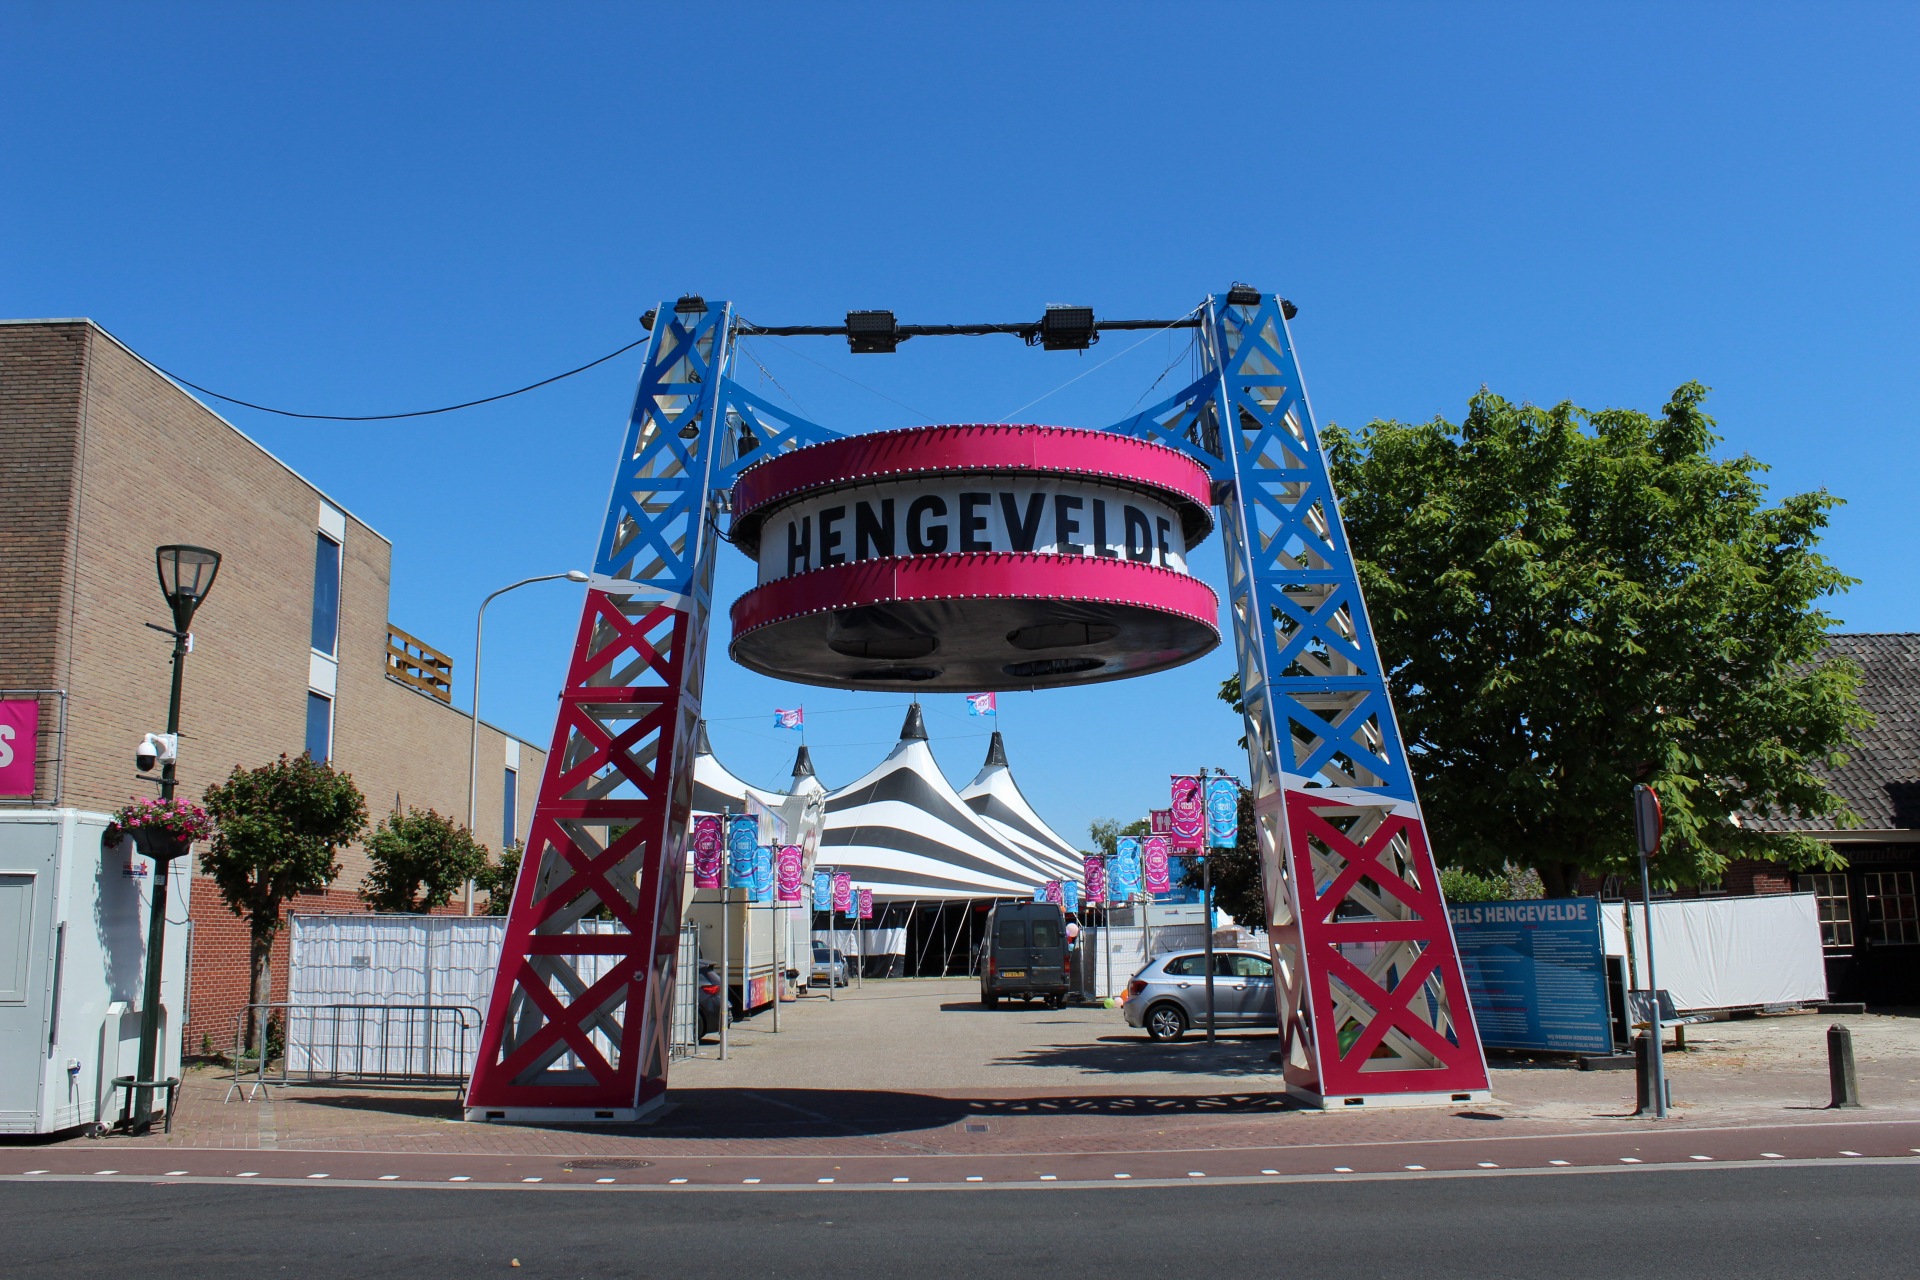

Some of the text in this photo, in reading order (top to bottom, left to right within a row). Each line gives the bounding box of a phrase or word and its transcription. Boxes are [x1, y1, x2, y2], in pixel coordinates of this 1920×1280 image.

[787, 492, 1175, 573] HENGEVELDE
[0, 724, 20, 768] S
[1485, 904, 1588, 922] HENGEVELDE
